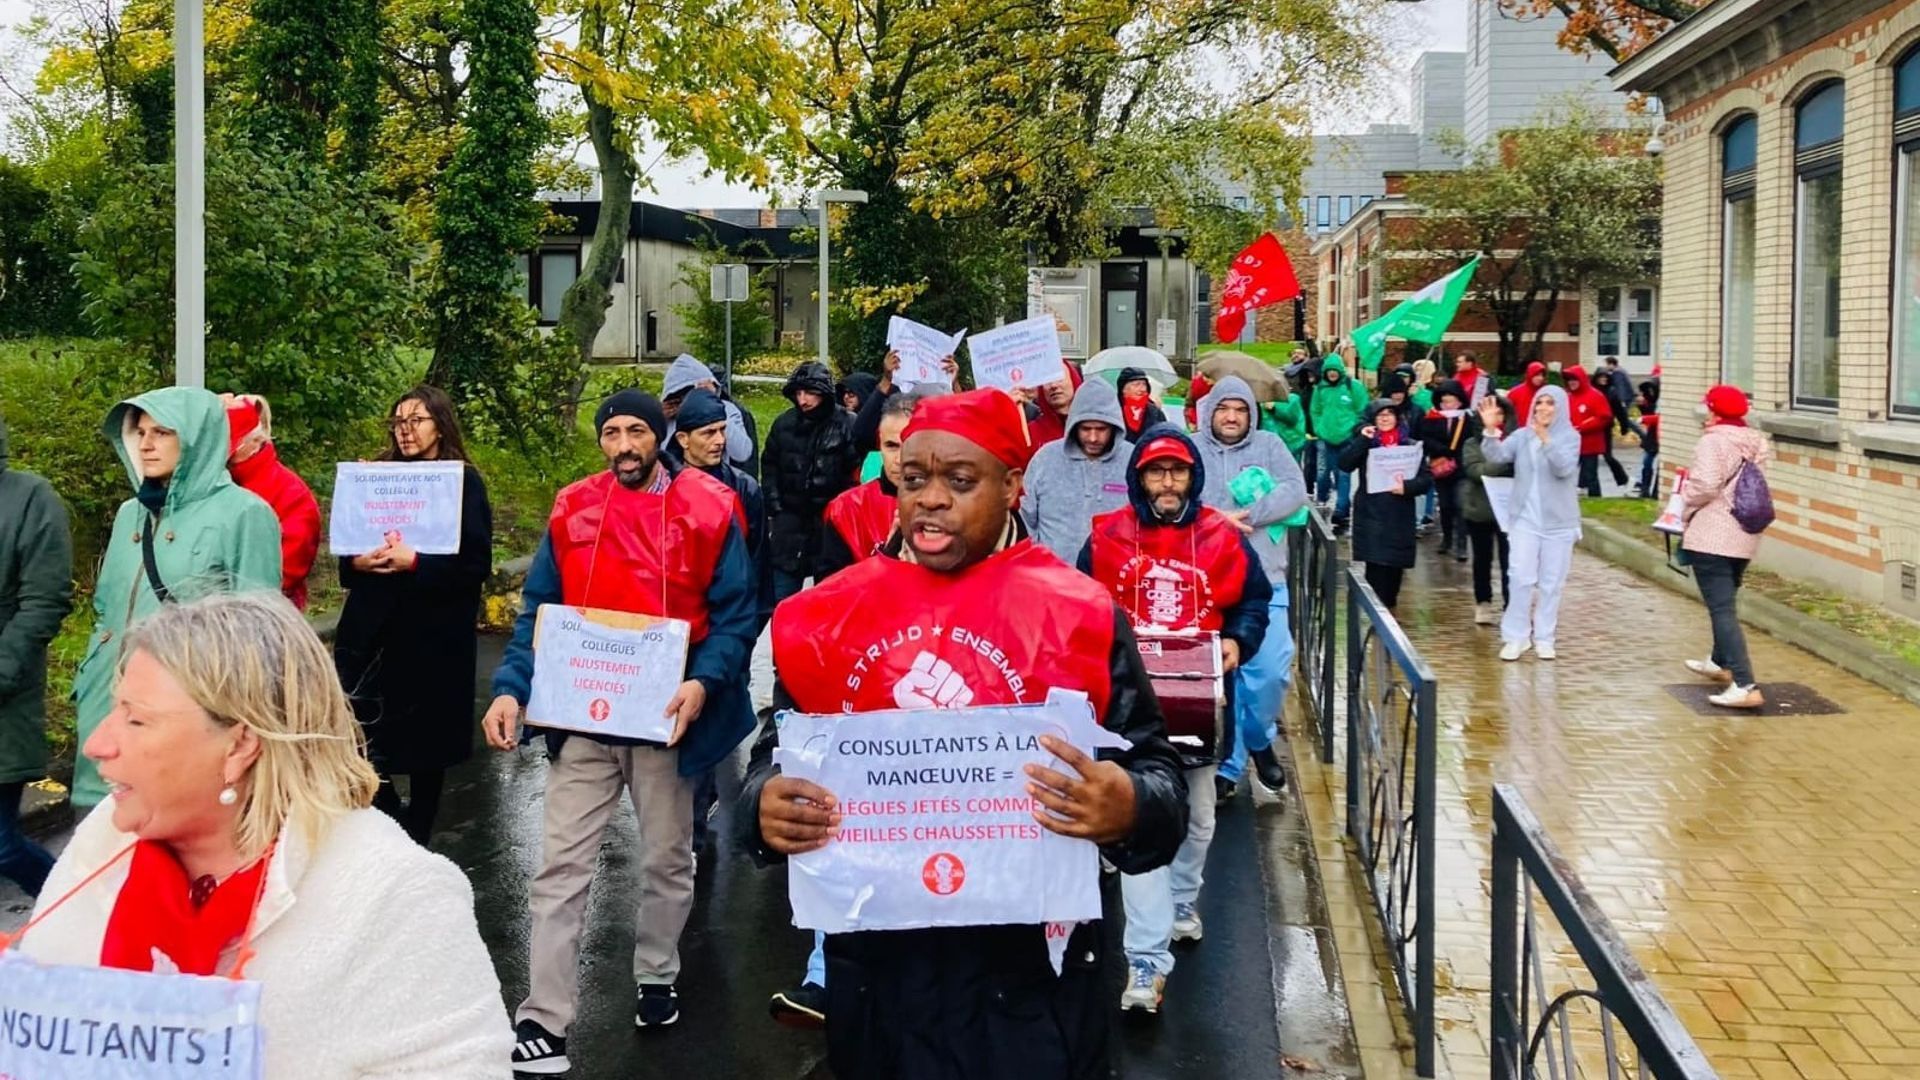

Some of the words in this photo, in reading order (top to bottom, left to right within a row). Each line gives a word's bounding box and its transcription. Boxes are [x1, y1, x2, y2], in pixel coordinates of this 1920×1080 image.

[401, 474, 423, 482] AVEC
[424, 473, 442, 482] NOS
[643, 632, 664, 643] NOS
[569, 656, 641, 677] INJUSTEMENT
[846, 625, 922, 691] STRIJD
[574, 677, 625, 695] LICENCIÉS
[838, 736, 988, 756] CONSULTANTS
[995, 731, 1009, 751] À
[1016, 736, 1040, 751] LA
[867, 767, 996, 787] MANŒUVRE
[911, 795, 960, 814] JETÉS
[967, 797, 1039, 814] COMME
[836, 825, 908, 843] VIEILLES
